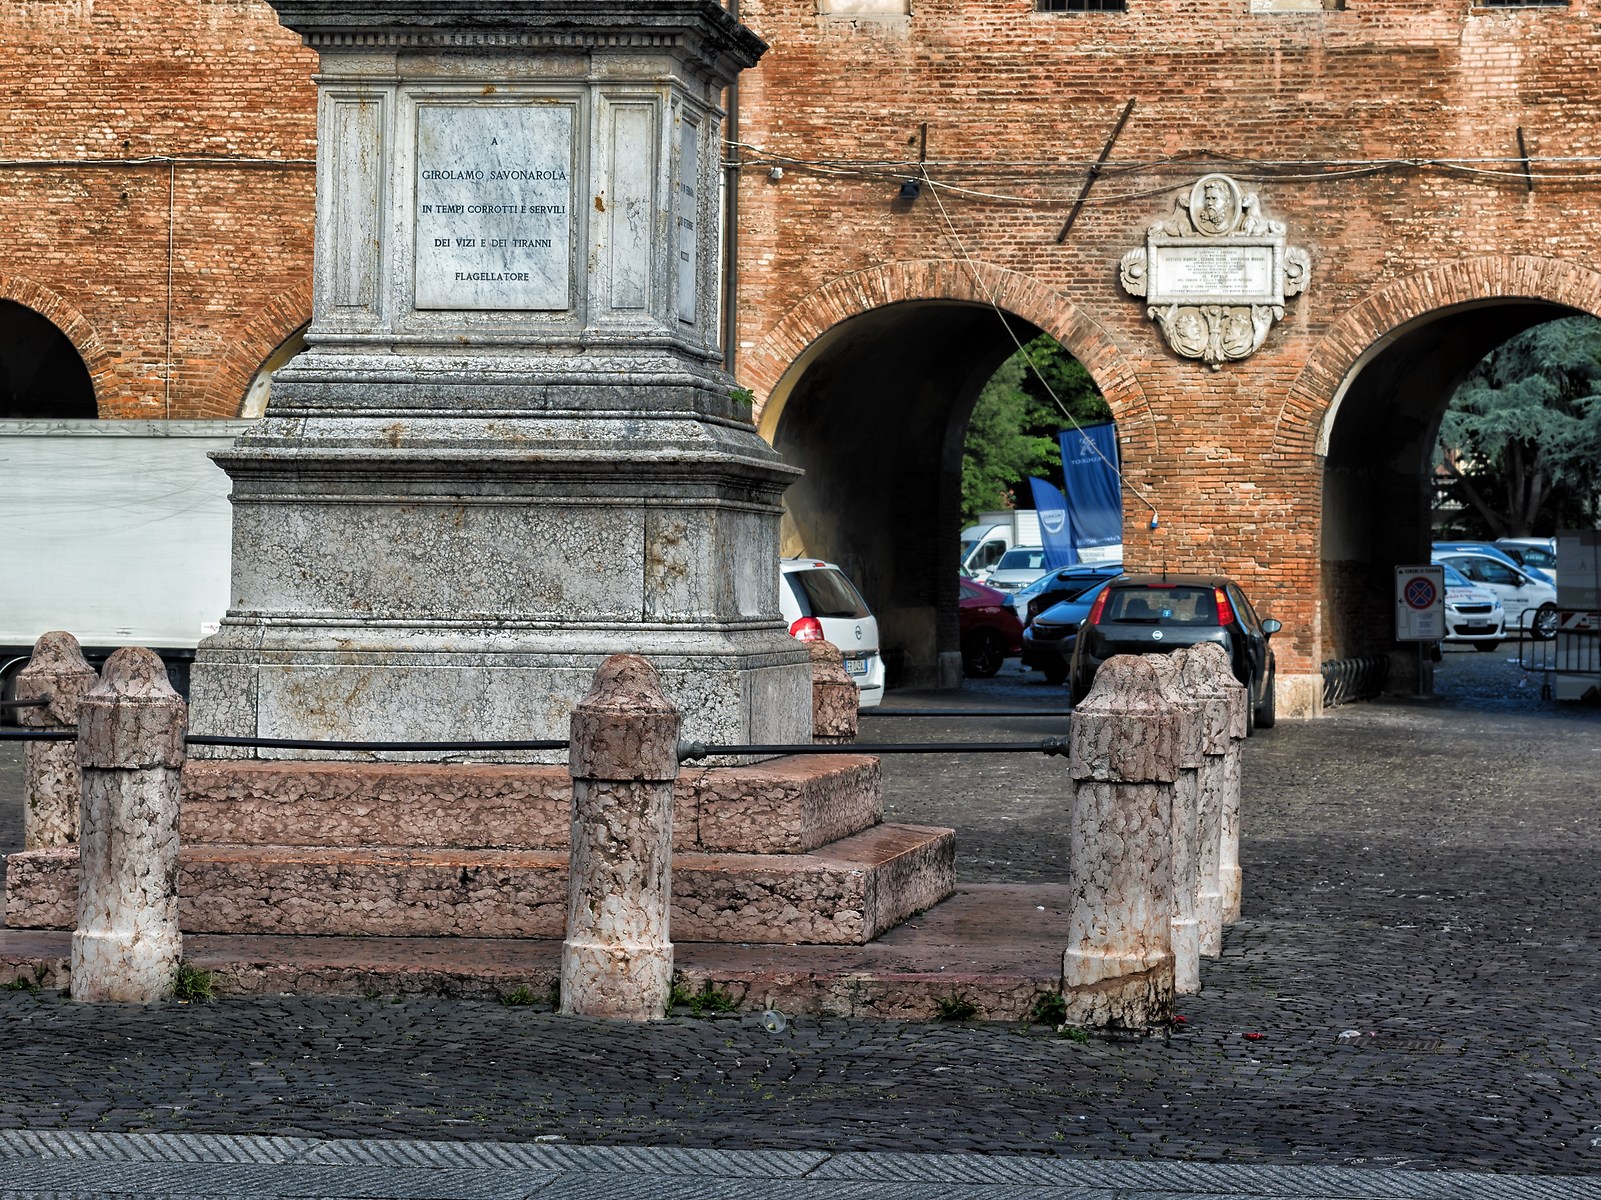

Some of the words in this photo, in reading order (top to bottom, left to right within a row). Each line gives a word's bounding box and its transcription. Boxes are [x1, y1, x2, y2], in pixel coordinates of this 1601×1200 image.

[491, 137, 498, 146] A
[422, 170, 484, 180] GIROLAMO
[490, 170, 567, 180] SAVONAROLA
[422, 205, 432, 214] IN
[436, 205, 465, 214] TEMPI
[467, 205, 518, 214] CORROTTI
[521, 205, 526, 214] E
[529, 205, 565, 214] SERVILI
[434, 239, 451, 248] DEI
[456, 239, 476, 248] VIZI
[480, 239, 486, 248] E
[491, 239, 507, 248] DEI
[513, 239, 551, 248] TIRANNI
[455, 272, 530, 282] FLAGELLATORE
